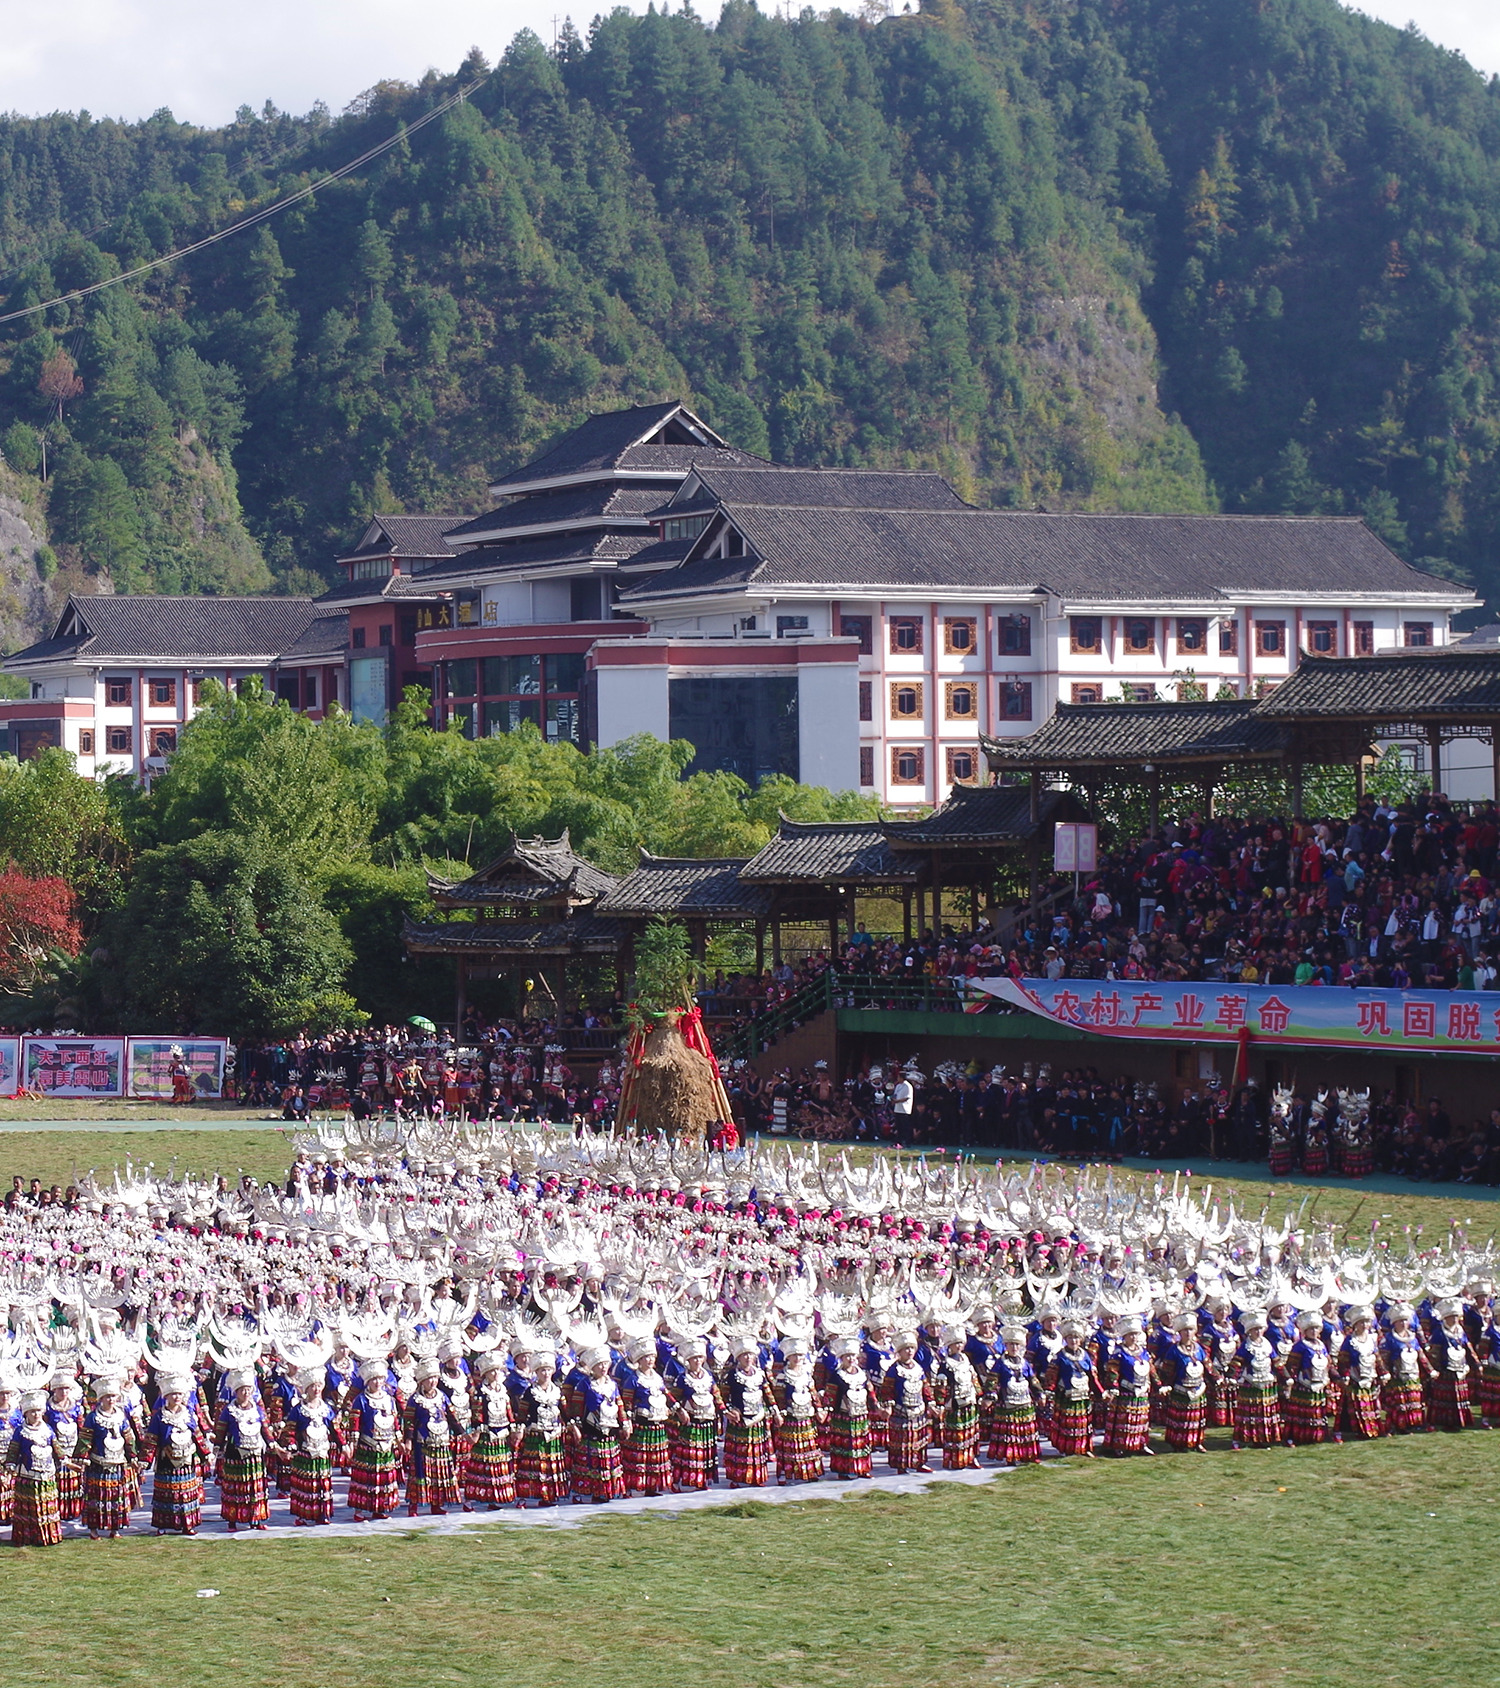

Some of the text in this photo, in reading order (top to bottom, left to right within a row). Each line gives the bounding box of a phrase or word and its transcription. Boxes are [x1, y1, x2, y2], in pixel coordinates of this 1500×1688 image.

[1030, 989, 1500, 1042] 农村产业革命 巩固脱
[38, 1050, 108, 1065] 天下西江
